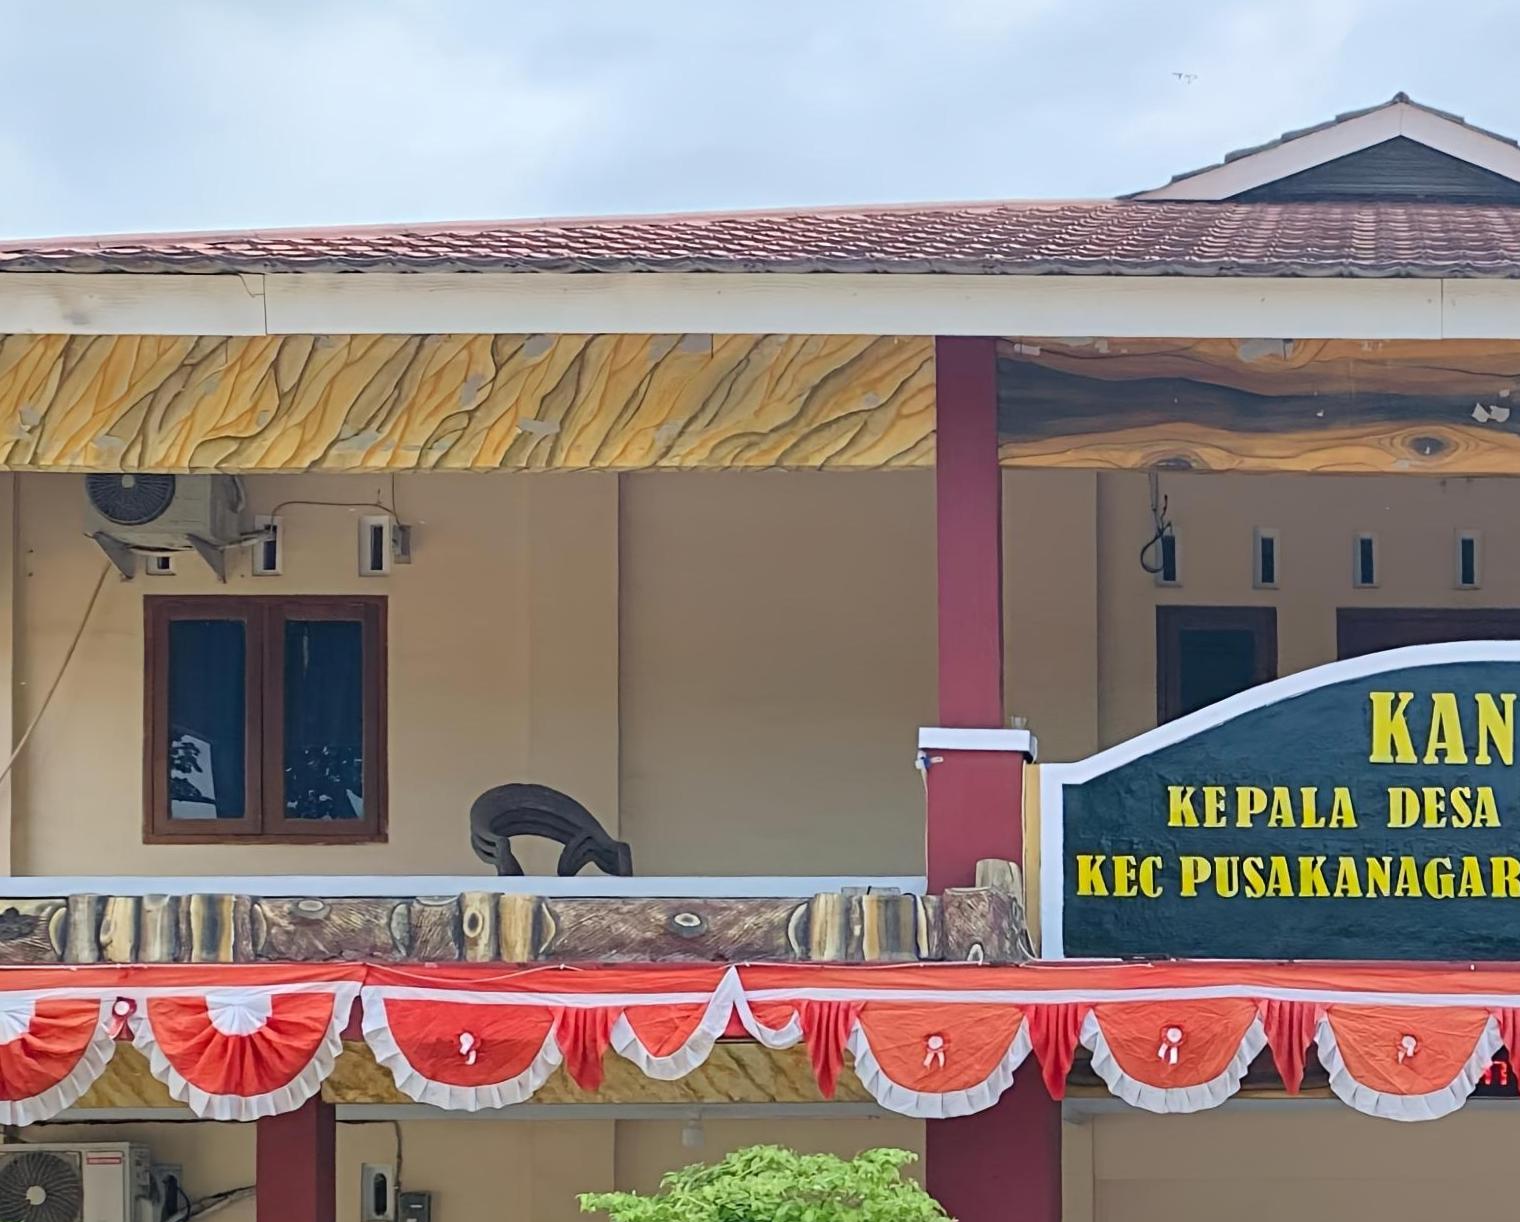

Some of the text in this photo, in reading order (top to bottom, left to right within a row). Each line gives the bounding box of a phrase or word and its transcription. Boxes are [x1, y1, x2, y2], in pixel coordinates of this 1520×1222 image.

[1167, 785, 1357, 829] KEPALA
[1387, 786, 1500, 828] DESA
[1076, 855, 1164, 899] KEC
